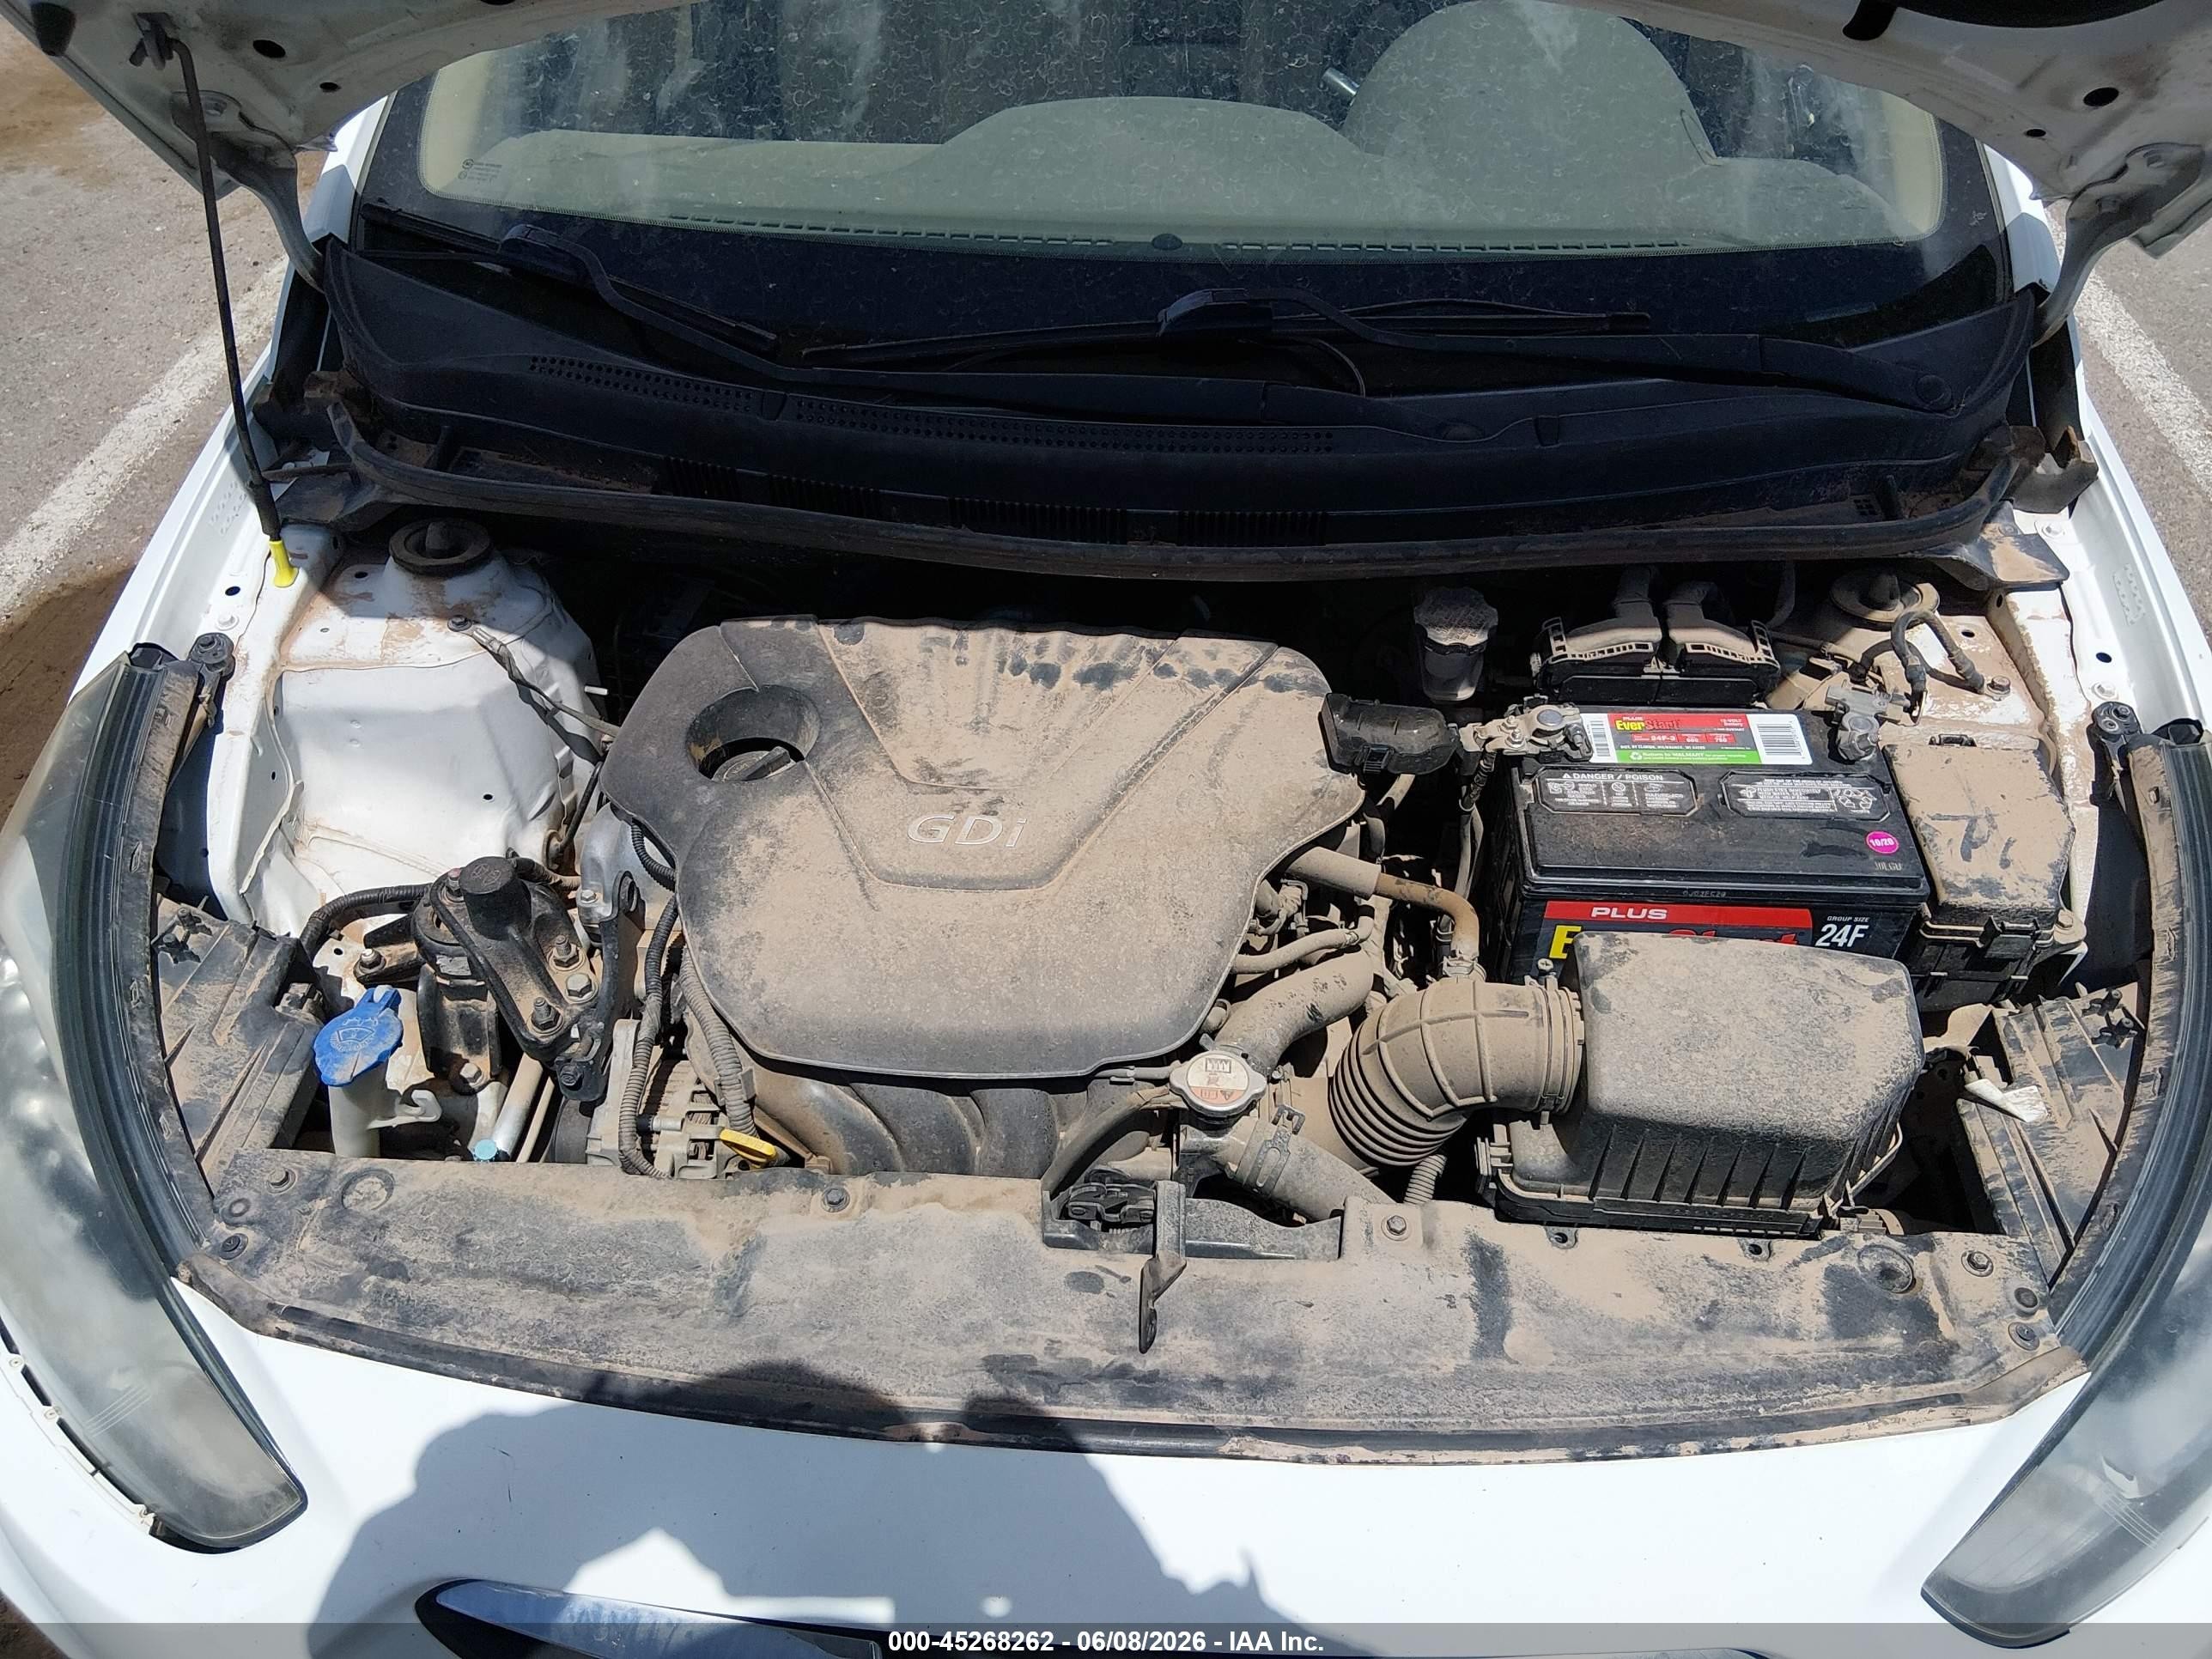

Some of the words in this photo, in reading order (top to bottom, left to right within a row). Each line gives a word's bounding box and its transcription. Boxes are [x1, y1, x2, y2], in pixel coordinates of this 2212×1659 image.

[1615, 720, 1678, 730] EverStart
[907, 814, 1028, 848] GDi
[1869, 837, 1894, 847] 10/20
[1590, 907, 1668, 920] PLUS
[1815, 924, 1869, 947] 24F
